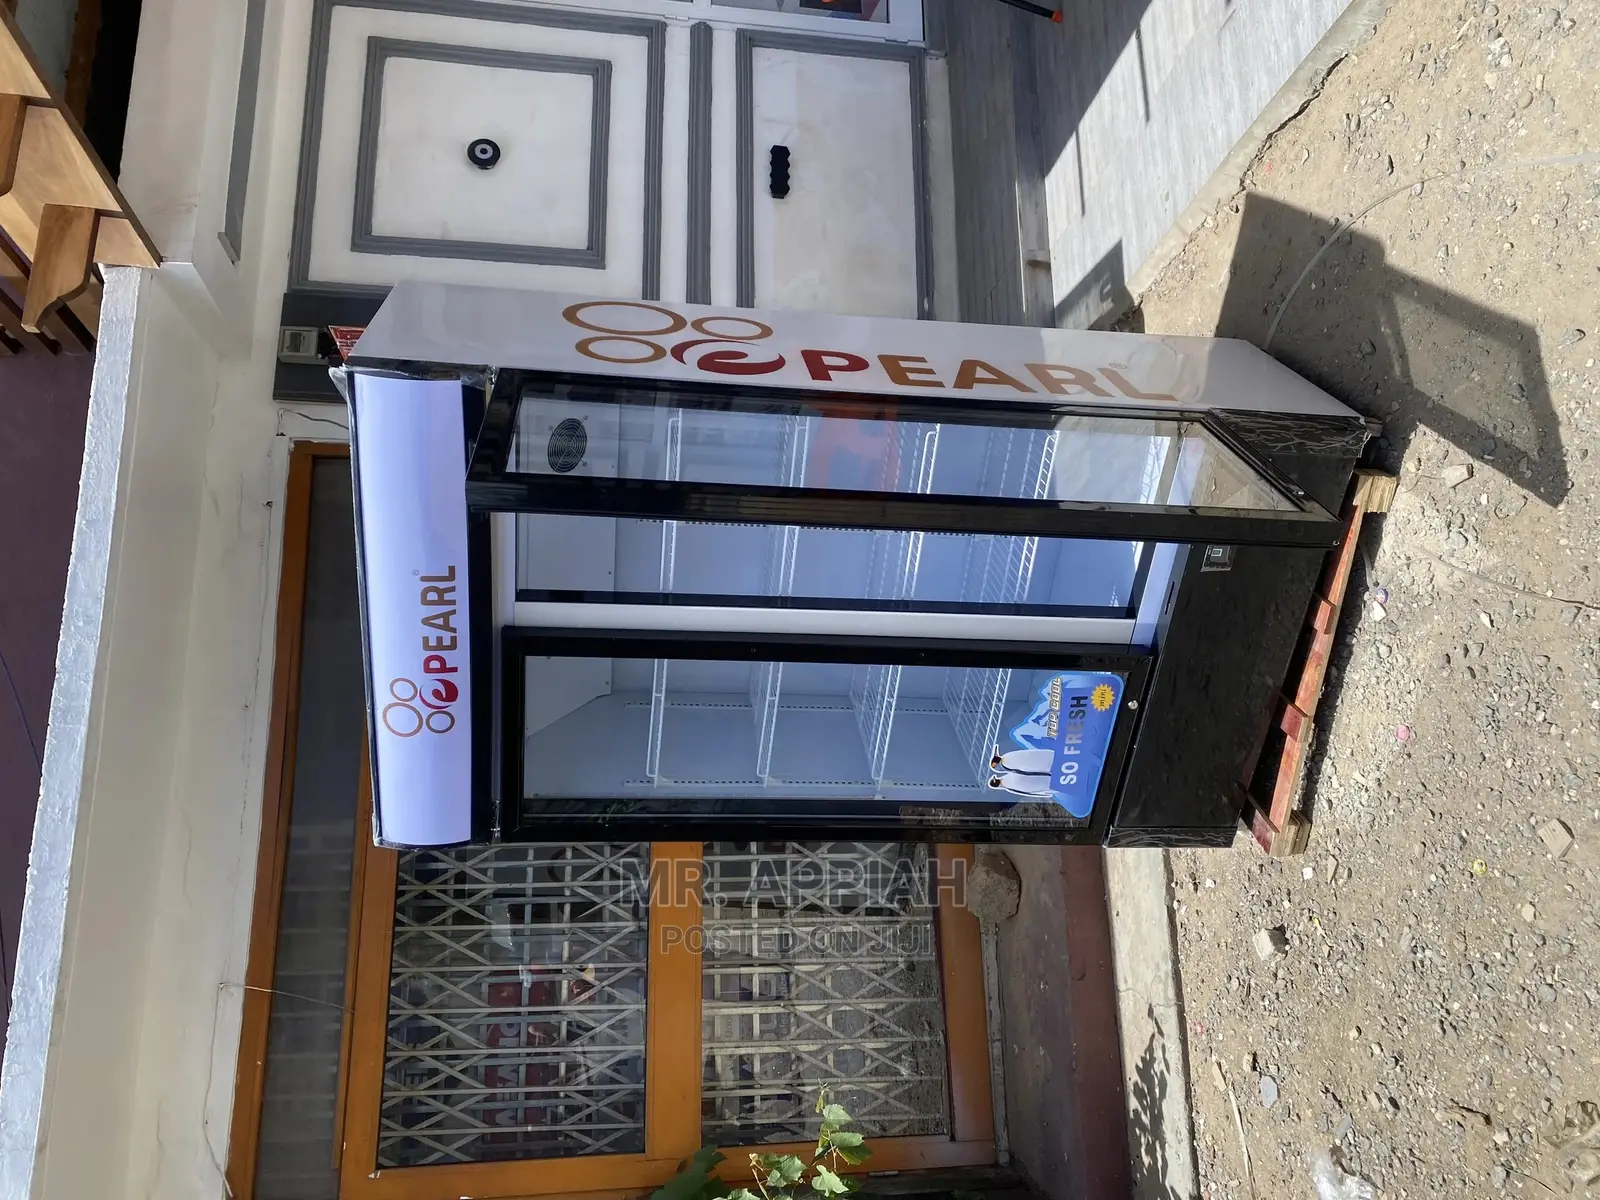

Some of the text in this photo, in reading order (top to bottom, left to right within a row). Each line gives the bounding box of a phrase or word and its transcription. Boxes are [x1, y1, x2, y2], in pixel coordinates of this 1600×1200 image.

[801, 349, 1178, 401] PEARL
[419, 565, 459, 674] PEARL
[1047, 677, 1062, 738] TOP COOL
[1059, 696, 1088, 786] SO FRESH
